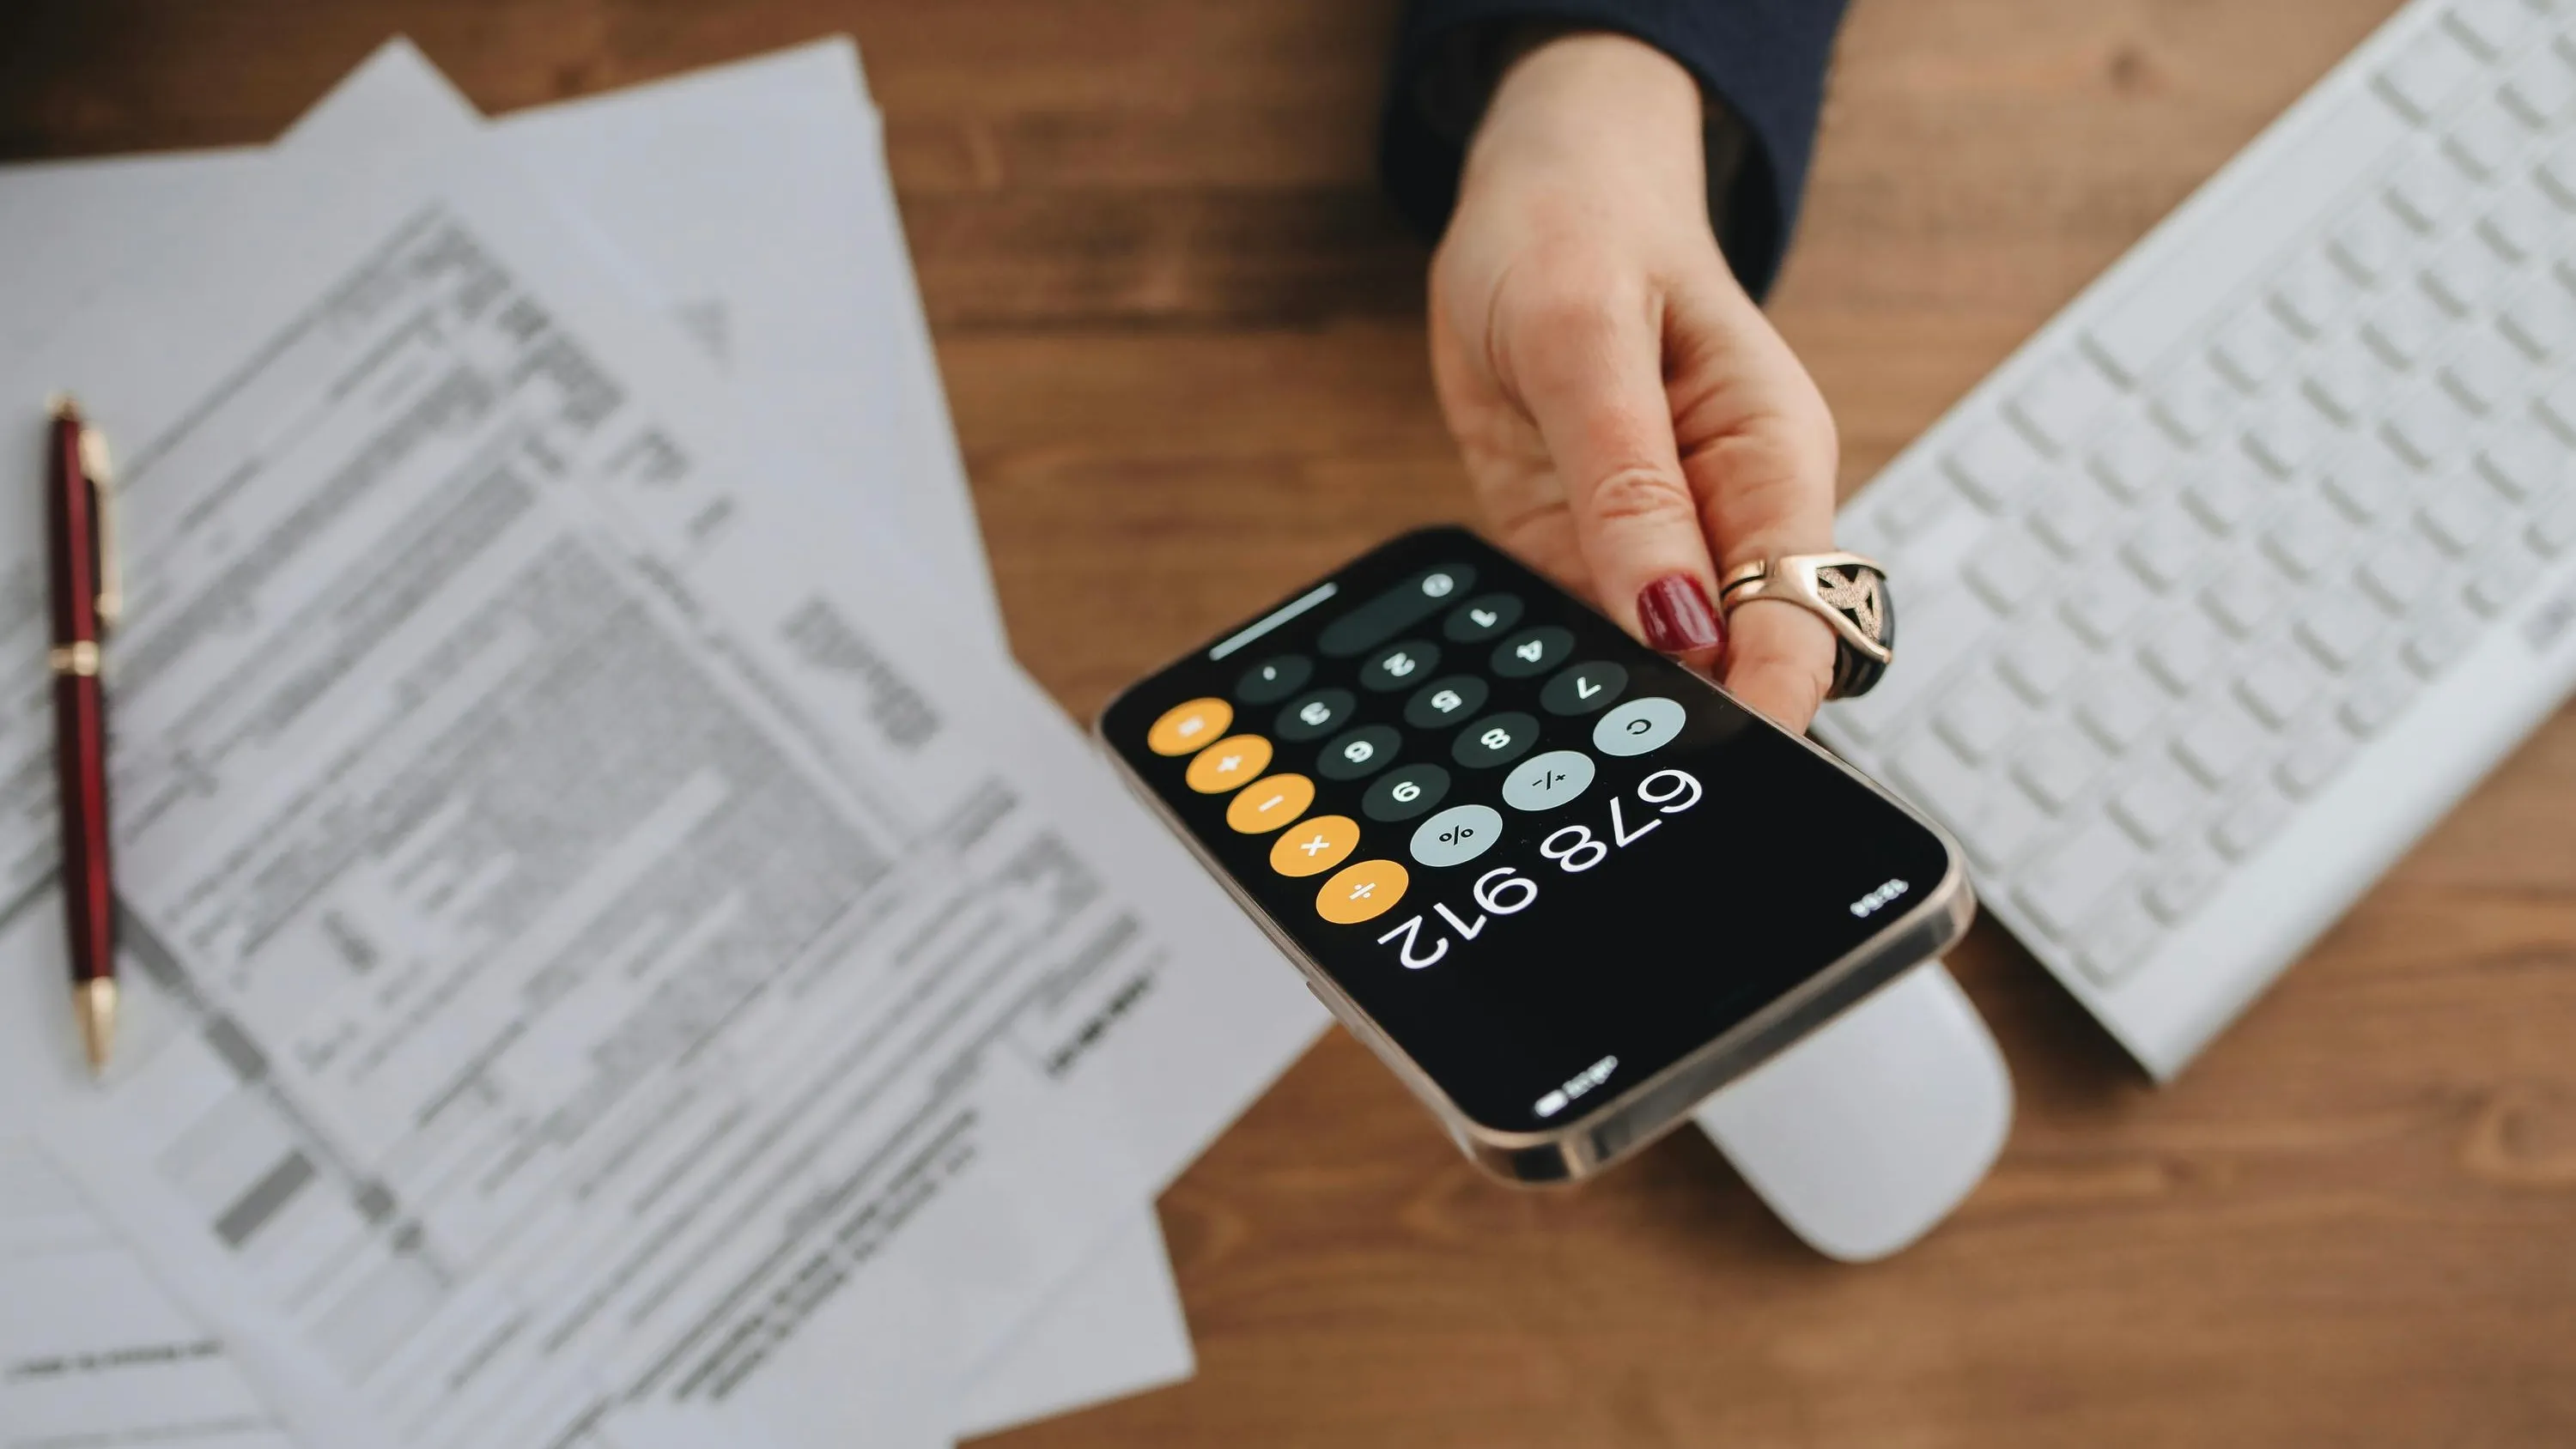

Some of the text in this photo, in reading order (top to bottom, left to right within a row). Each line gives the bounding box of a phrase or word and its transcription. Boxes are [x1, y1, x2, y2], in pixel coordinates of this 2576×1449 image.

[1471, 609, 1497, 627] 1
[1516, 640, 1542, 662] 4
[1383, 652, 1415, 676] 2
[1577, 677, 1601, 699] 7
[1431, 690, 1461, 712] 5
[1300, 702, 1331, 725] 3
[1625, 718, 1652, 735] C
[1481, 728, 1510, 749] 8
[1345, 741, 1373, 762] 6
[1392, 781, 1421, 802] 9
[1438, 825, 1475, 846] %
[1376, 769, 1703, 970] 678 912
